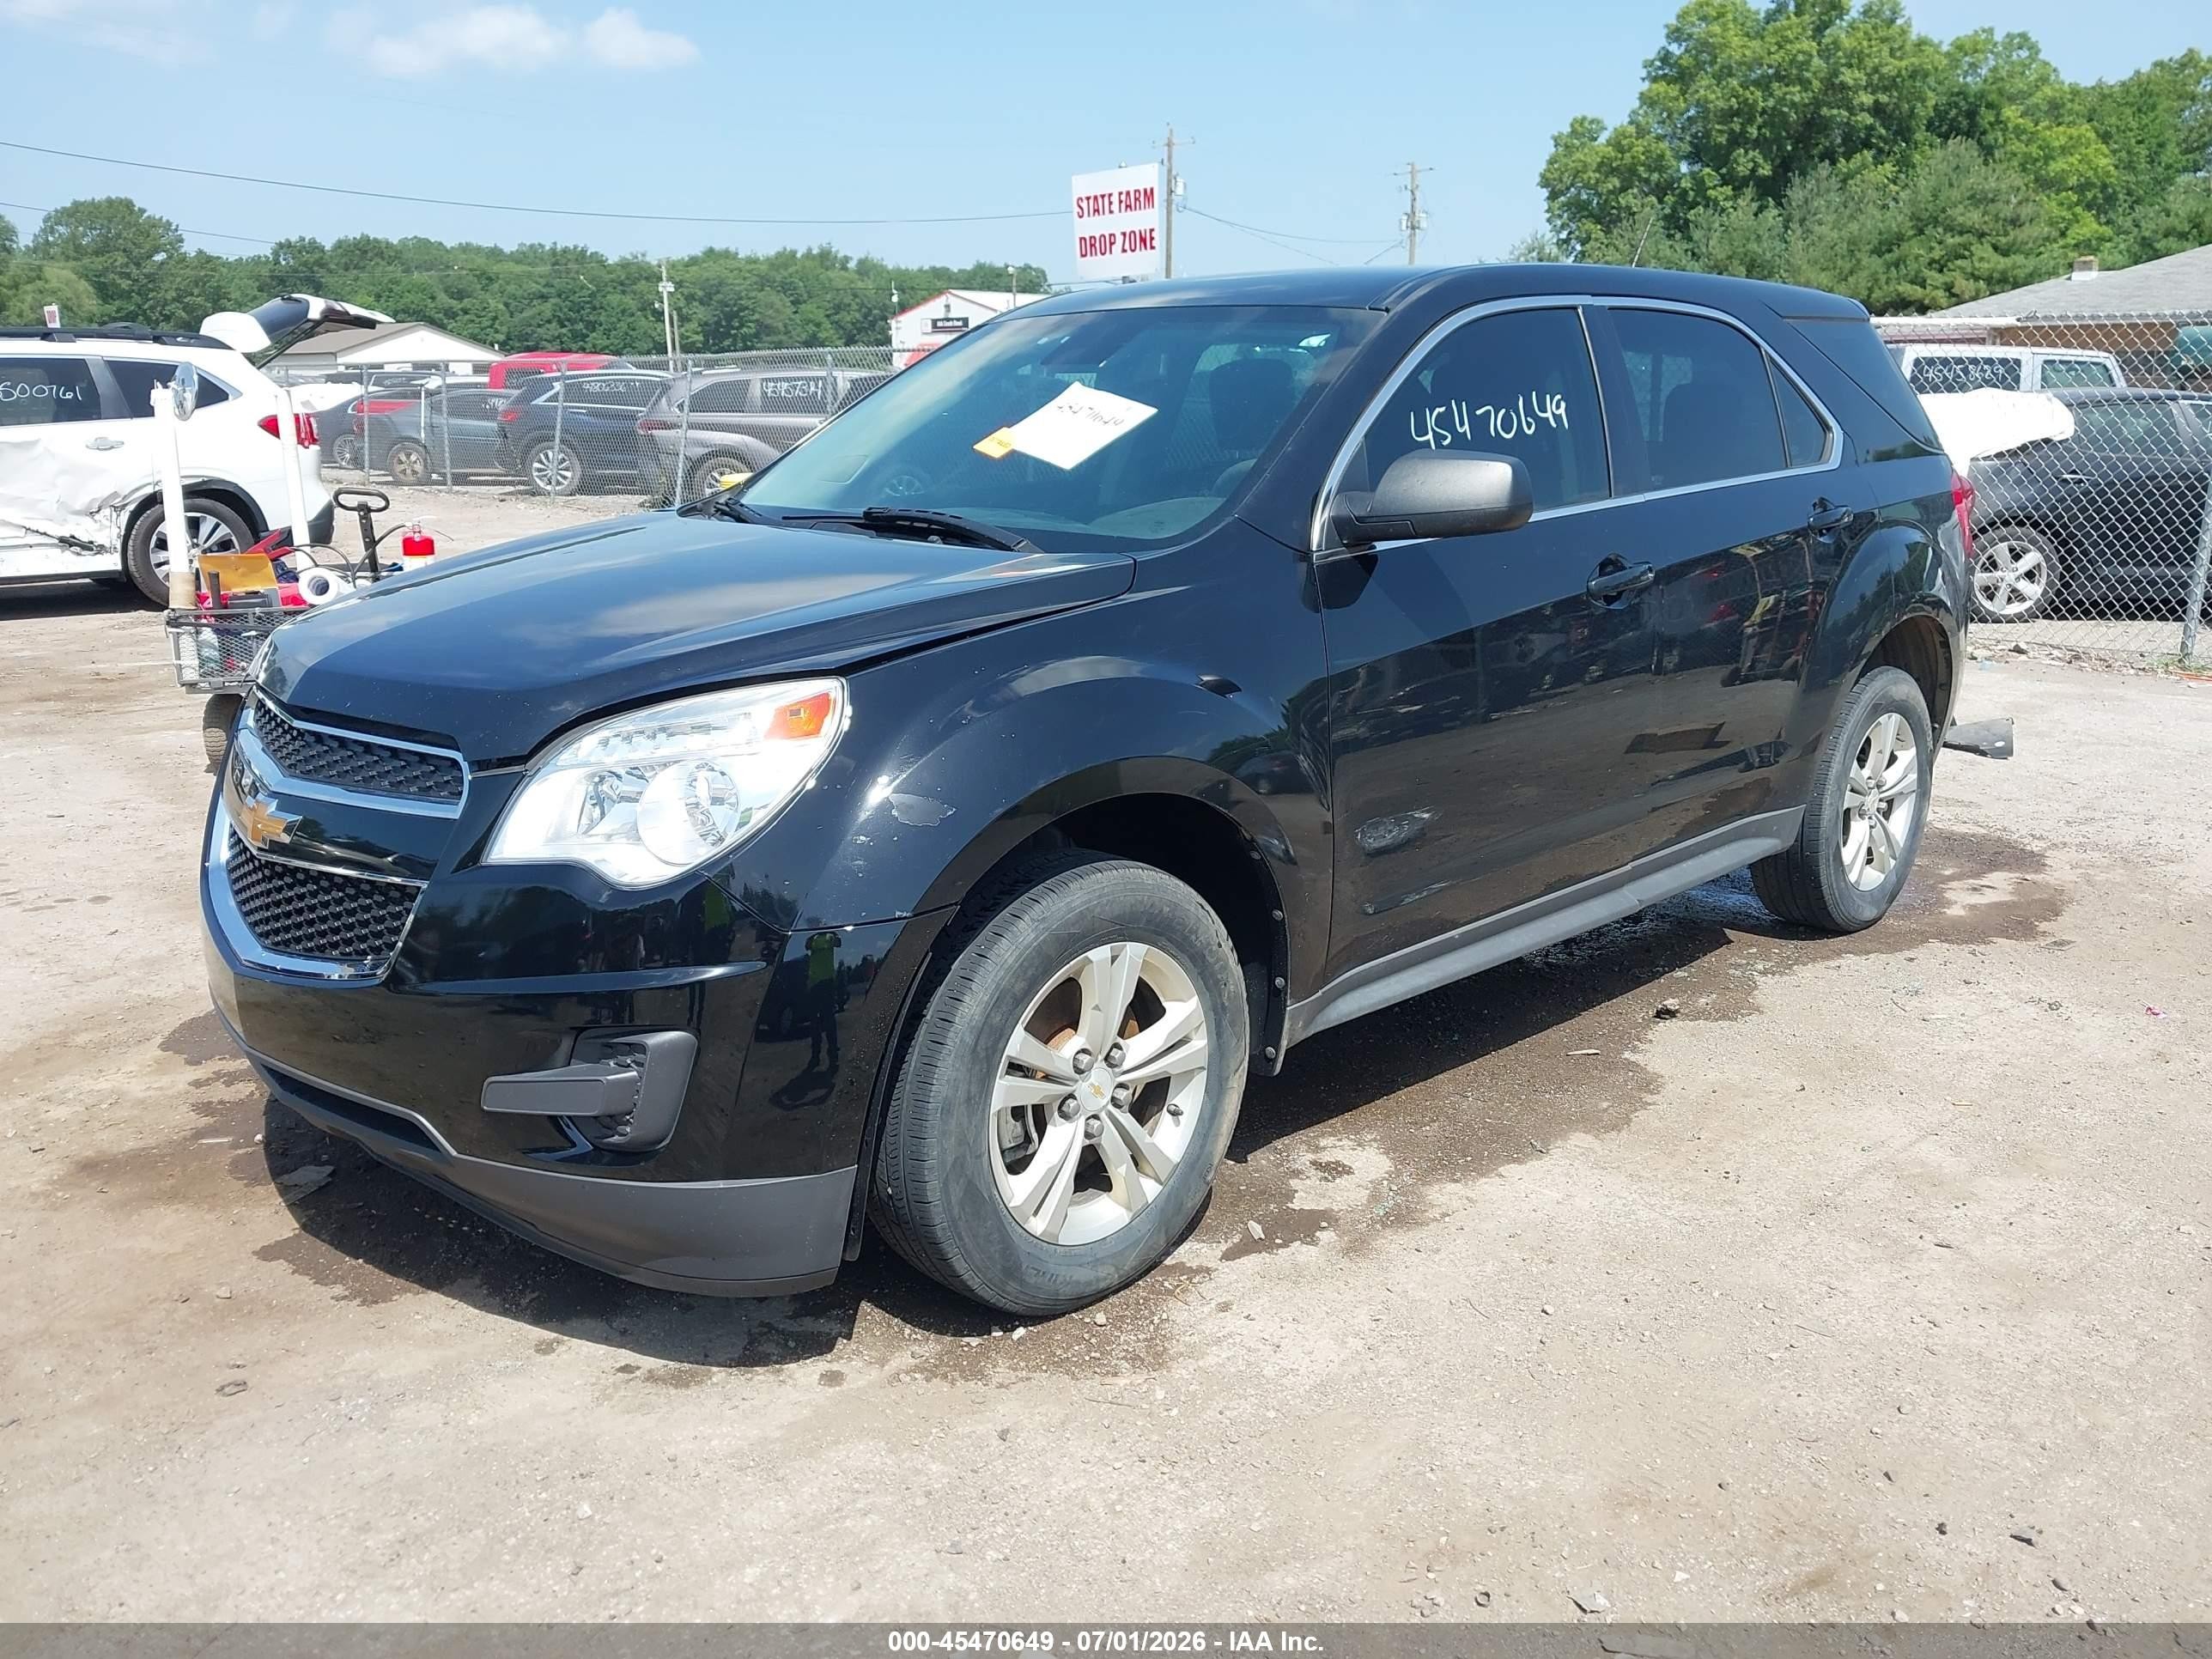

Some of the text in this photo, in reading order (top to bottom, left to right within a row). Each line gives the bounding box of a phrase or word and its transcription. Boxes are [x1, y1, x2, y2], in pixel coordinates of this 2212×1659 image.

[1076, 186, 1155, 219] STATE FARM
[1079, 228, 1156, 258] DROP ZONE
[1410, 391, 1569, 451] 45470649
